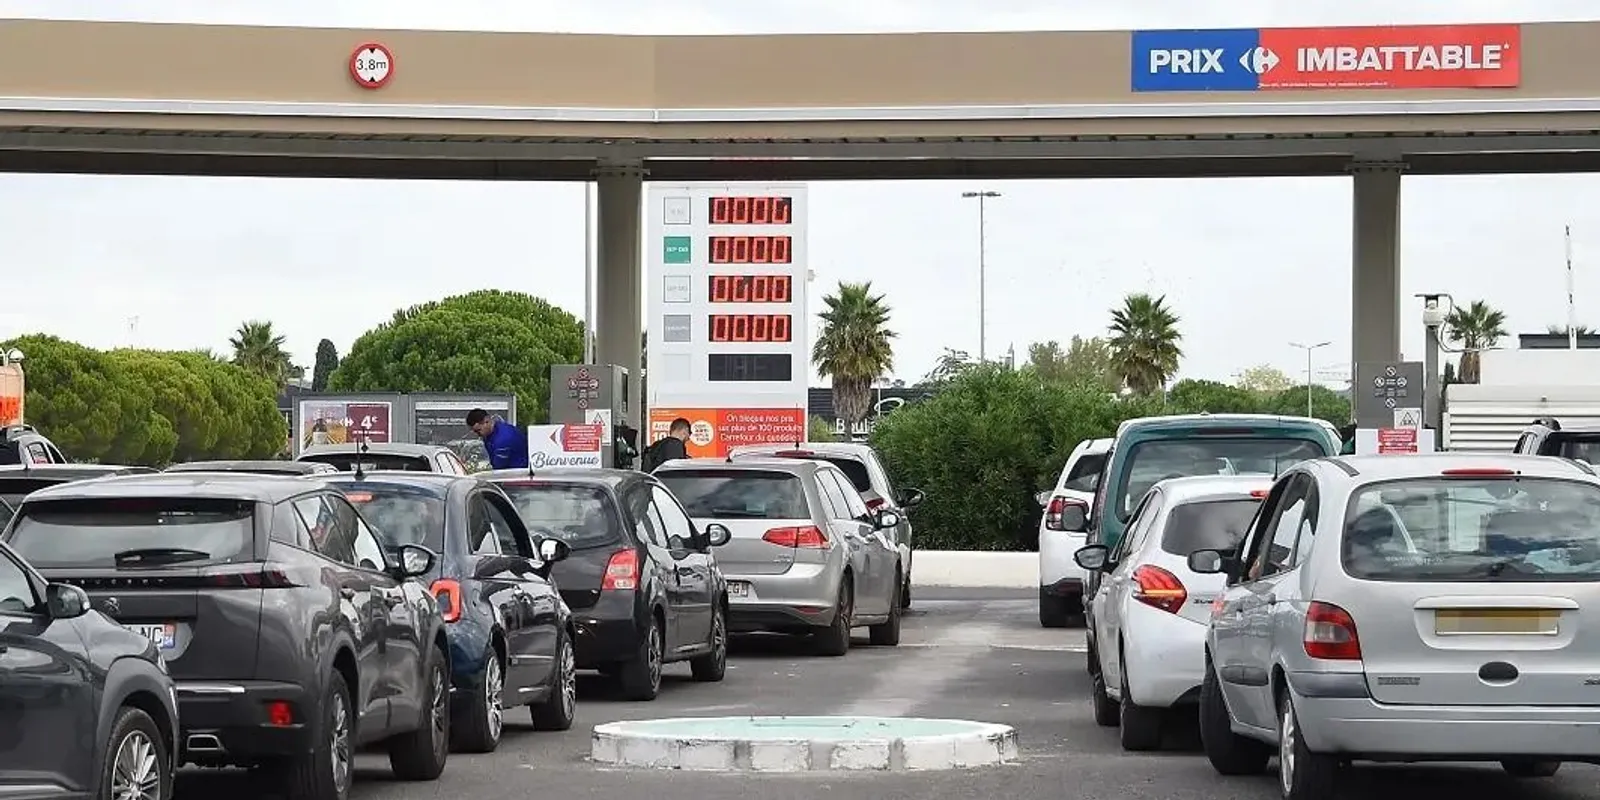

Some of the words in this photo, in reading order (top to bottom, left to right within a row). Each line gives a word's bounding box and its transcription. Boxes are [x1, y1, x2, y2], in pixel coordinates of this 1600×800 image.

[356, 58, 387, 71] 3.8m
[1149, 48, 1226, 74] PRIX
[726, 413, 738, 422] On
[739, 413, 764, 424] bloque
[765, 414, 779, 423] nos
[731, 424, 746, 433] plus
[747, 424, 758, 432] de
[758, 424, 772, 432] 100
[720, 432, 755, 442] Carrefour
[755, 432, 765, 442] du
[531, 451, 599, 468] Bienvenue
